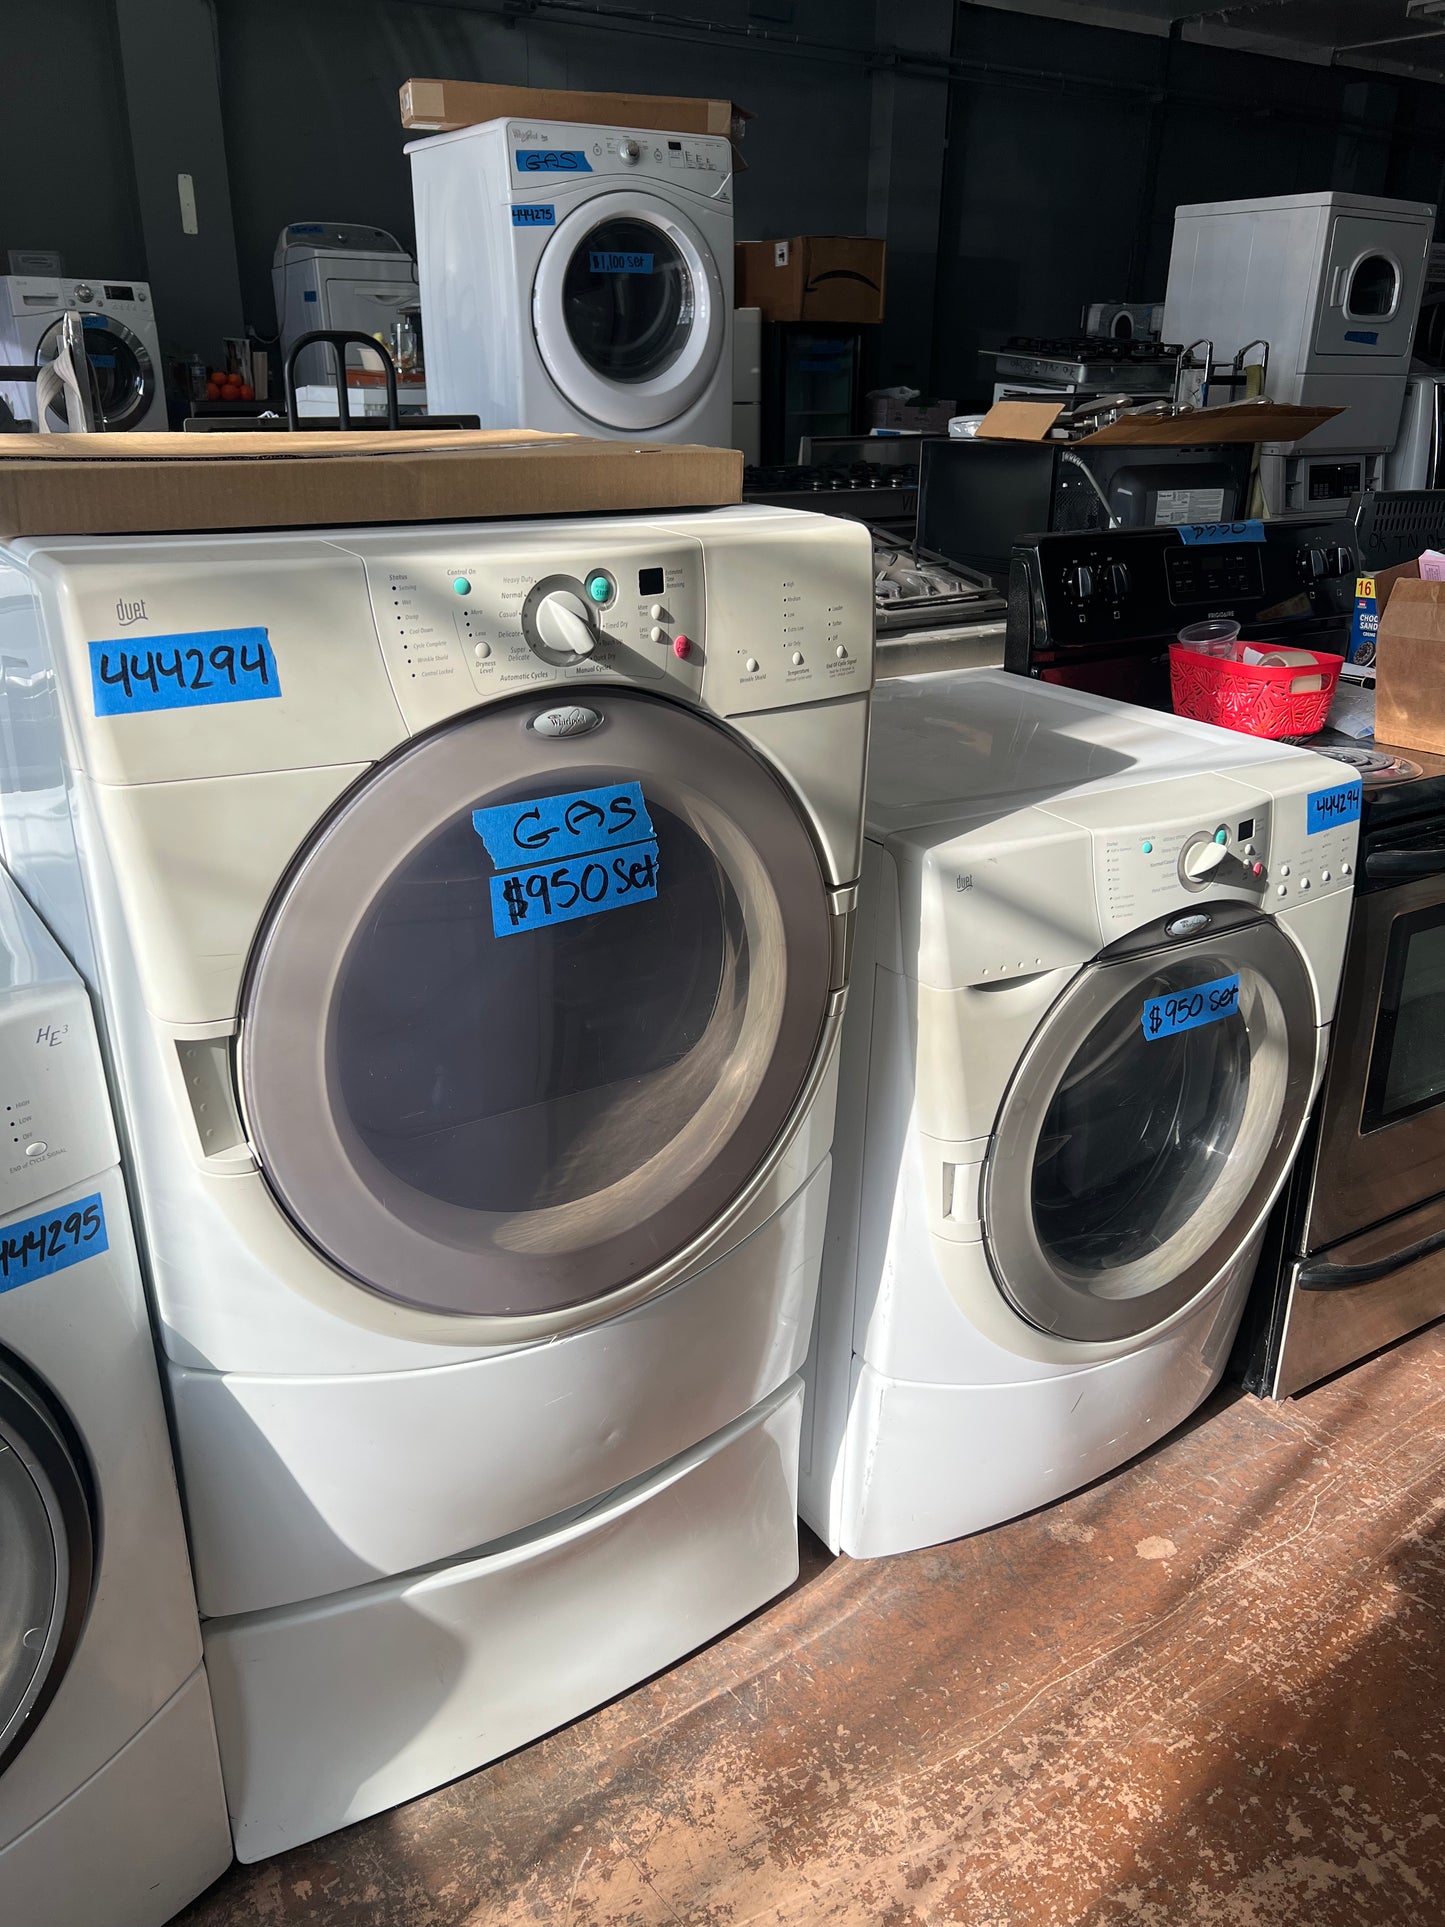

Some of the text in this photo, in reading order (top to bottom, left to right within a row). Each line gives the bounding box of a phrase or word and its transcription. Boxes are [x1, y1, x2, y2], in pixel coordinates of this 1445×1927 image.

[525, 152, 579, 170] GAS
[447, 567, 477, 576] Control On
[502, 576, 521, 585] Heavy
[1358, 580, 1372, 597] 16
[501, 591, 524, 600] Normal
[498, 609, 518, 618] Casual
[498, 630, 521, 639] Delicate
[509, 646, 527, 656] Super
[100, 642, 270, 699] 444294
[576, 665, 595, 673] Manual
[500, 670, 549, 682] Automatic Cycles
[1316, 787, 1360, 821] 444294
[512, 796, 638, 851] GAS
[502, 861, 610, 927] $950
[1148, 992, 1205, 1035] $950
